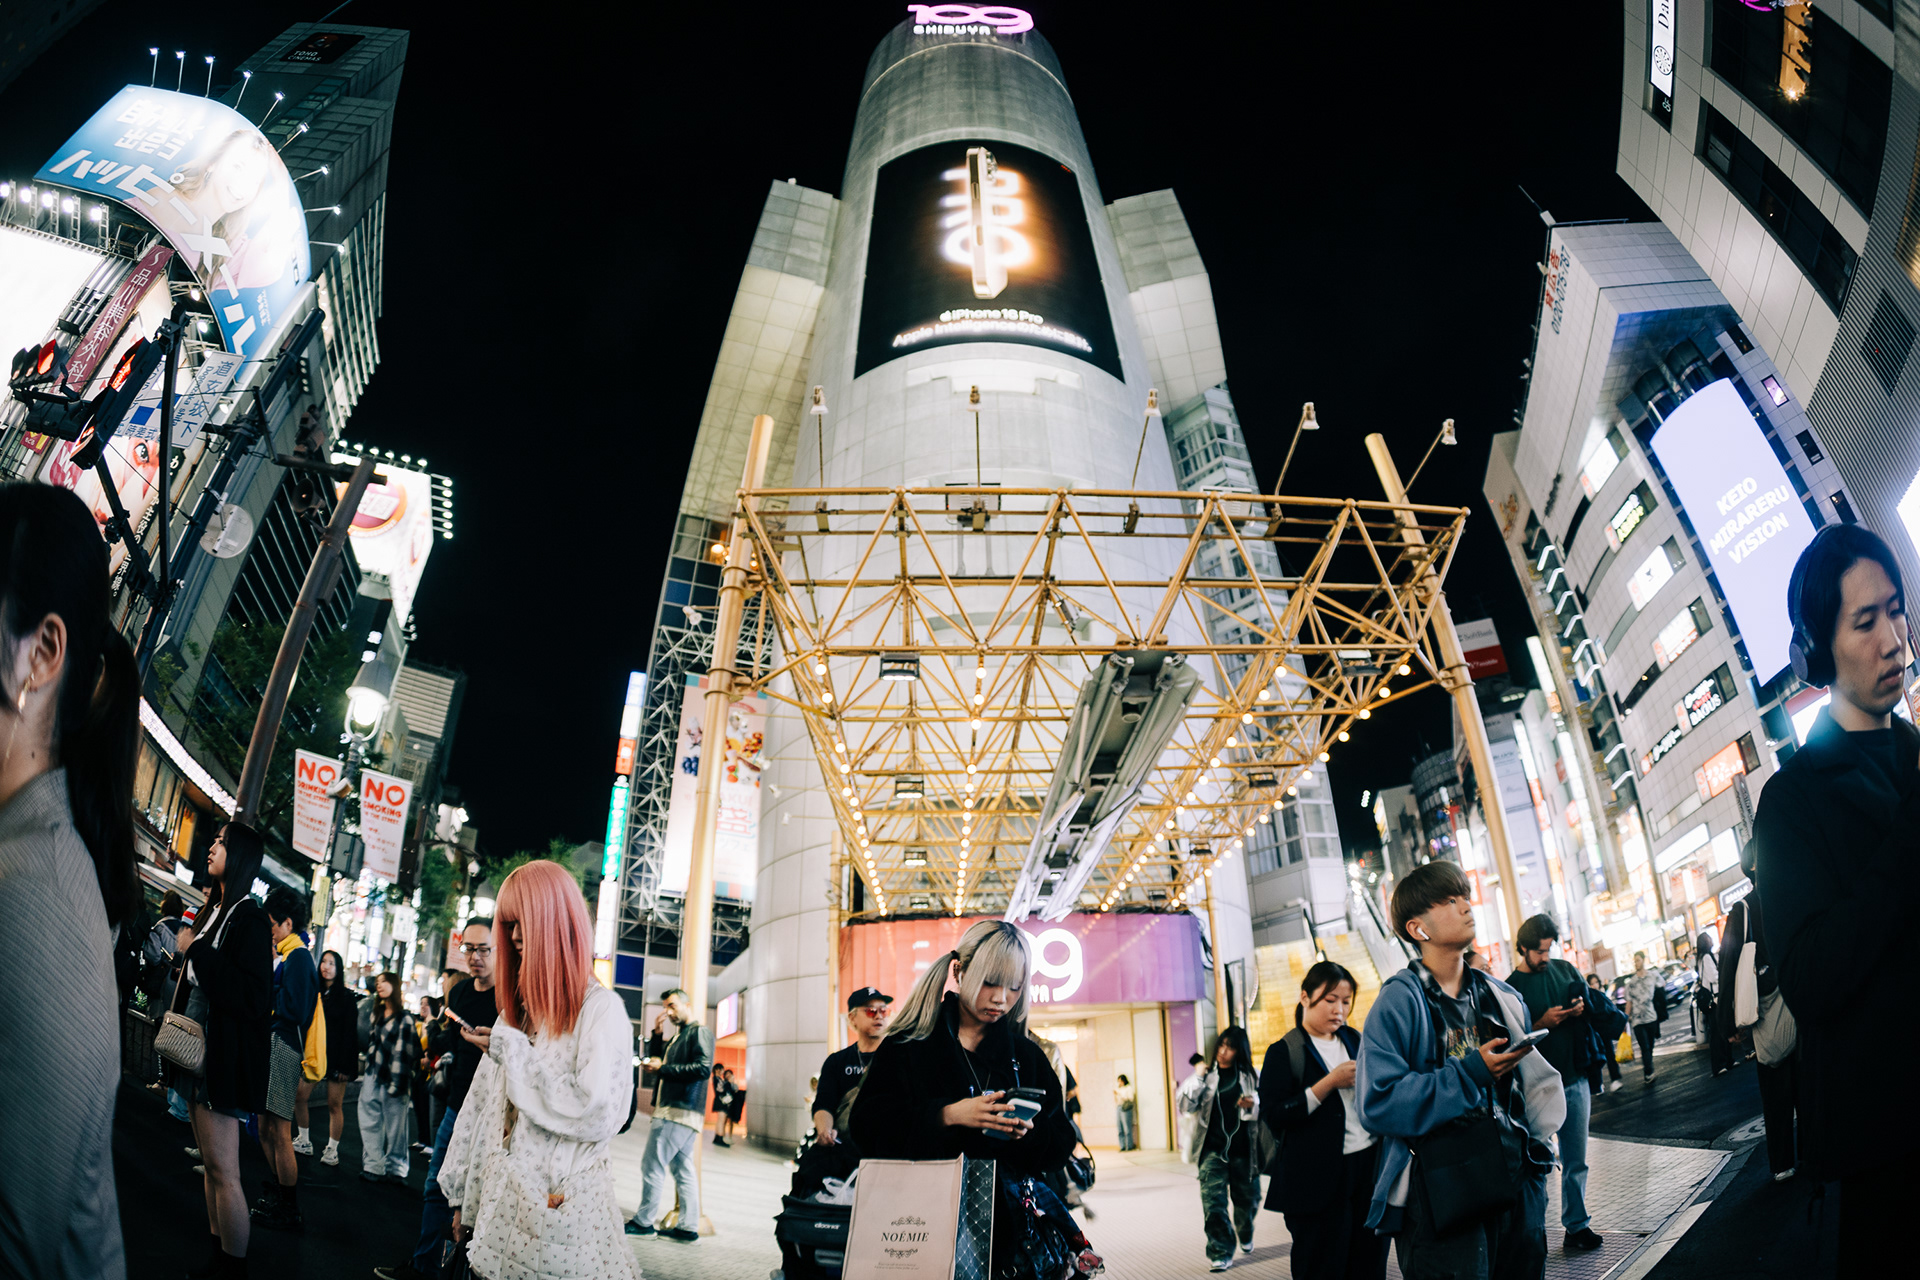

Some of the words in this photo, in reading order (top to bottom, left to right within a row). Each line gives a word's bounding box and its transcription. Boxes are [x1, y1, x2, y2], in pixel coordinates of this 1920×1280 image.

[907, 4, 1034, 34] 109
[1658, 0, 1669, 29] Da
[913, 24, 991, 35] SHIBUYA
[49, 149, 257, 357] ハッピーメール
[67, 268, 151, 383] 品川美容外科
[952, 308, 1001, 320] iPhone
[1001, 308, 1018, 320] 16
[1019, 310, 1043, 324] Pro
[893, 326, 933, 347] Apple
[181, 361, 234, 438] 道玄坂下
[1716, 477, 1757, 516] KEIO
[1709, 485, 1790, 555] MIRARERU
[1728, 512, 1790, 564] VISION
[299, 758, 336, 786] NO
[298, 781, 326, 795] DRINKIN
[364, 778, 405, 806] NO
[363, 801, 402, 818] SMOKING
[881, 1231, 929, 1242] NOÉMIE
